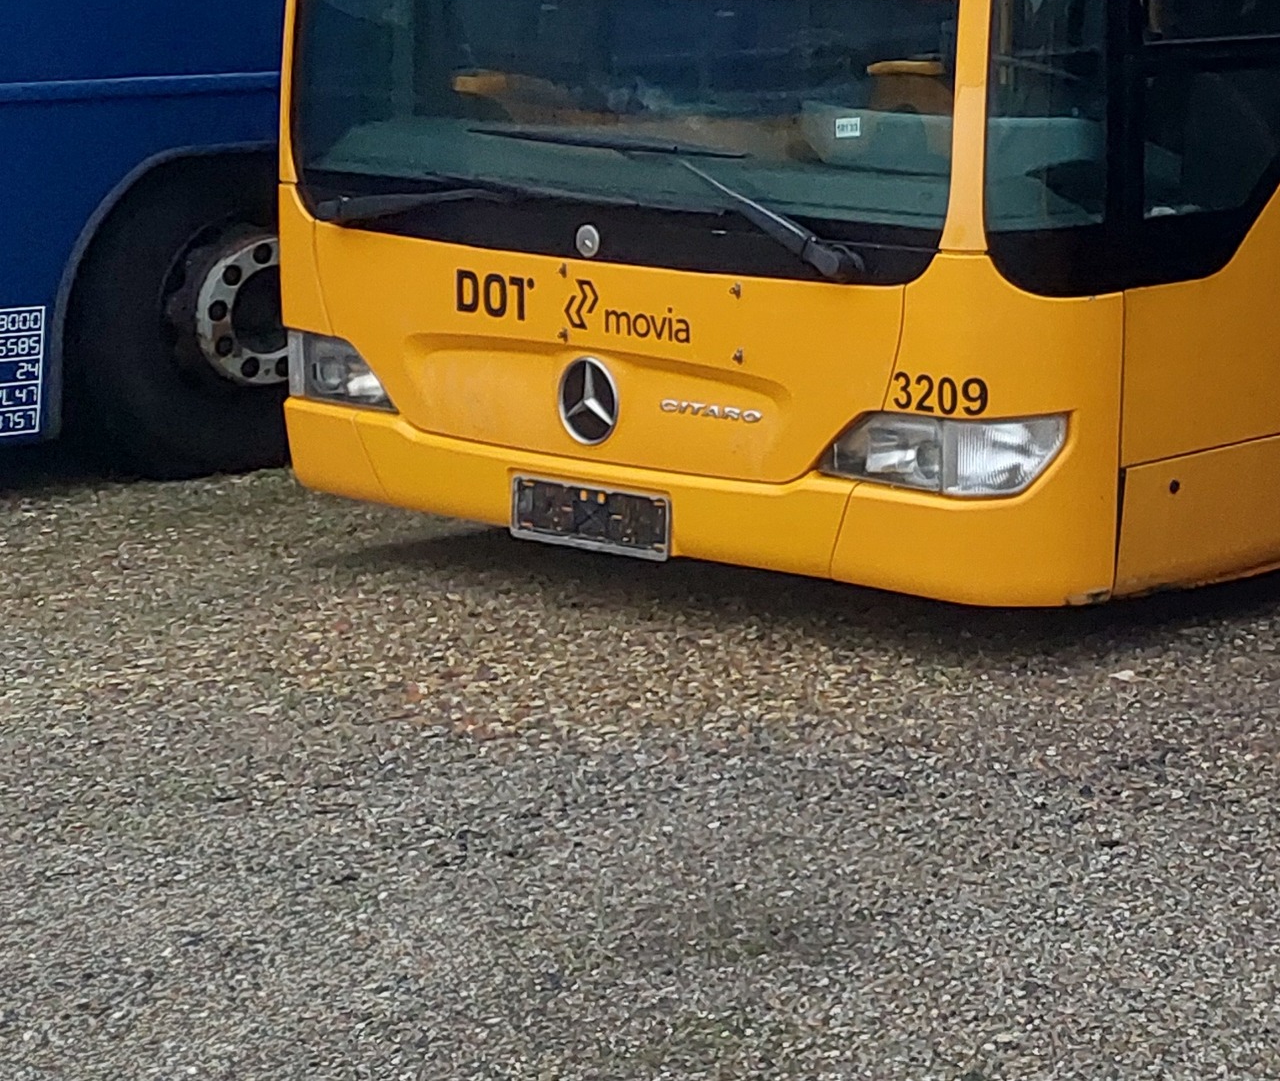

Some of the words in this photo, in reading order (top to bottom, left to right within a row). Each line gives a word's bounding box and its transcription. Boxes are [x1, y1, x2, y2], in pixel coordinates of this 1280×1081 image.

[456, 269, 534, 321] DOT
[604, 307, 691, 344] movia
[16, 363, 39, 380] 24
[659, 398, 763, 423] CITARO
[893, 371, 988, 416] 3209
